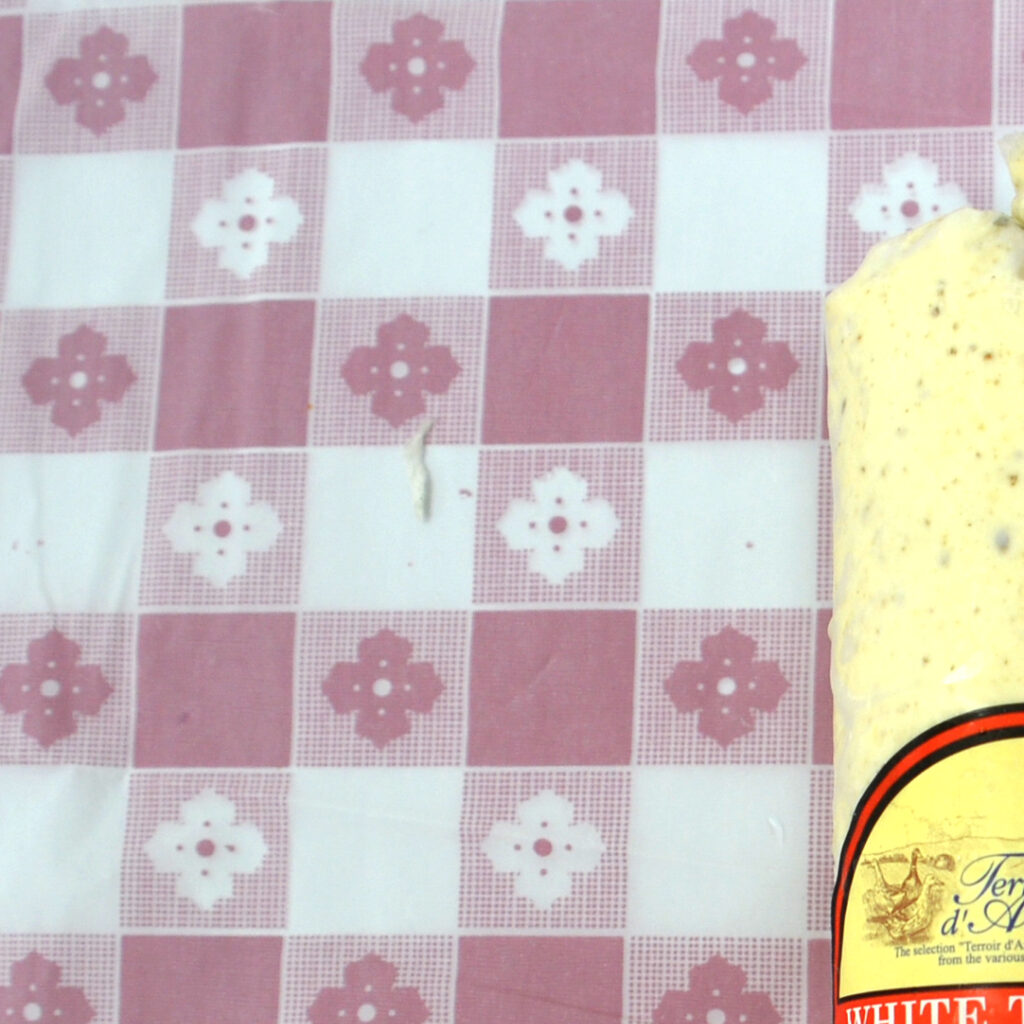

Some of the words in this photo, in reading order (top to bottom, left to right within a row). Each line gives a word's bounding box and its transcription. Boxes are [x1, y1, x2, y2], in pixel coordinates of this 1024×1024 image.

[894, 947, 911, 957] The
[913, 944, 956, 956] selection
[959, 940, 1001, 952] "Terroir
[938, 955, 962, 966] from
[965, 954, 982, 964] the
